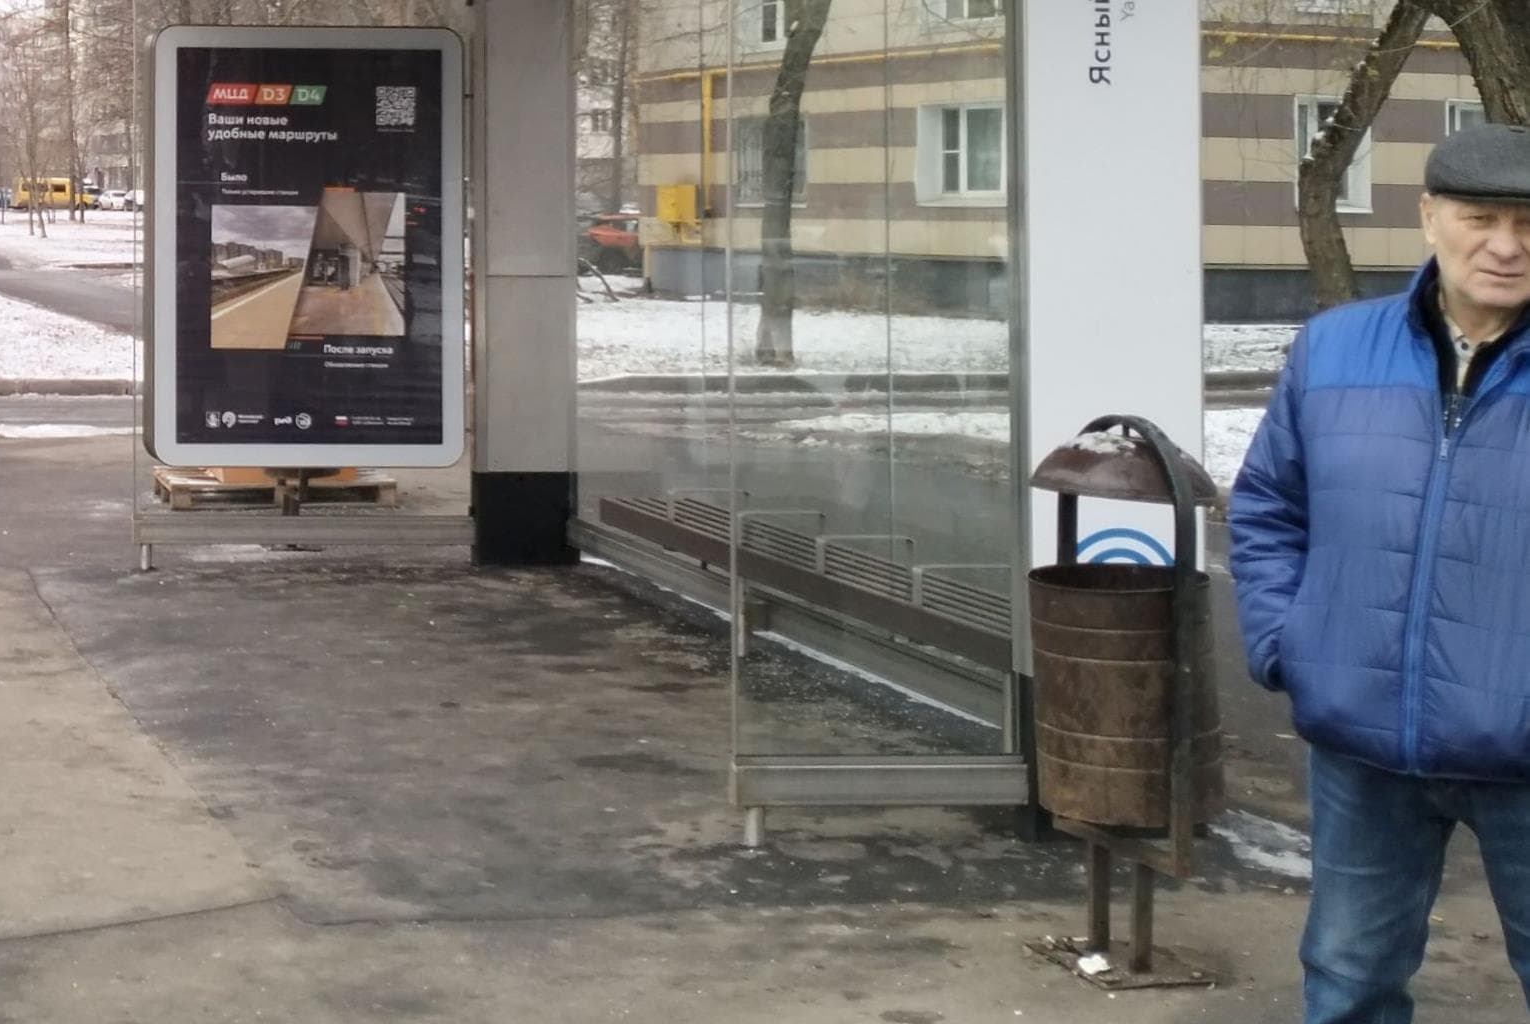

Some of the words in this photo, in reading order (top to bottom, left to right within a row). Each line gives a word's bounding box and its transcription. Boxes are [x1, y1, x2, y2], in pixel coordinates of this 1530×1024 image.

[213, 88, 249, 101] МЦД
[262, 89, 286, 101] D3
[297, 89, 321, 101] D4
[208, 113, 244, 125] Ваши
[247, 115, 288, 126] новые
[207, 127, 266, 141] удобные
[269, 130, 338, 143] маршруты
[220, 172, 248, 182] Было
[323, 344, 354, 355] После
[356, 346, 394, 356] запуска
